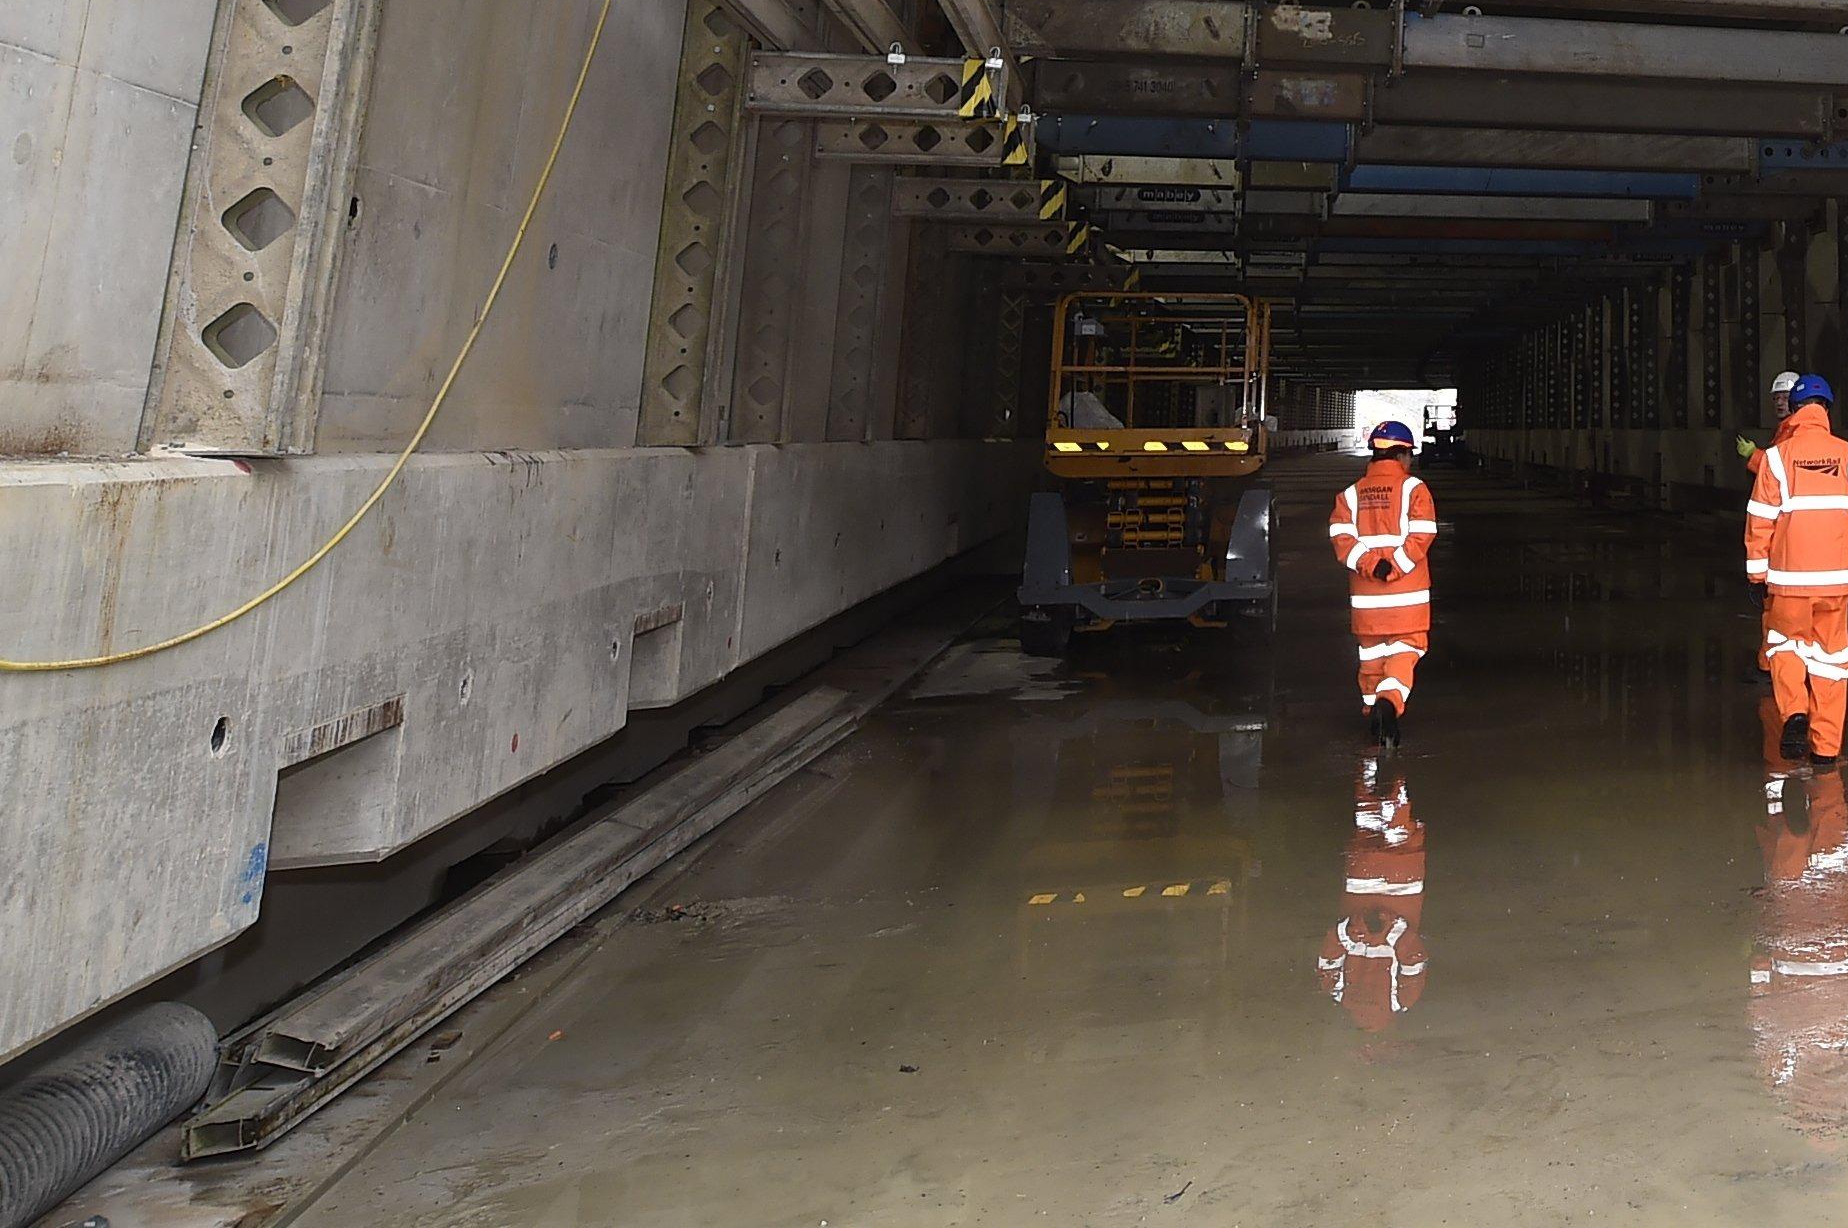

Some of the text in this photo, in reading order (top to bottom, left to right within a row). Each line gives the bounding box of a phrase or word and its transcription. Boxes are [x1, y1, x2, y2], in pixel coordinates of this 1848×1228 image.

[1793, 457, 1841, 466] Network Rail
[1359, 486, 1393, 494] MORGAN
